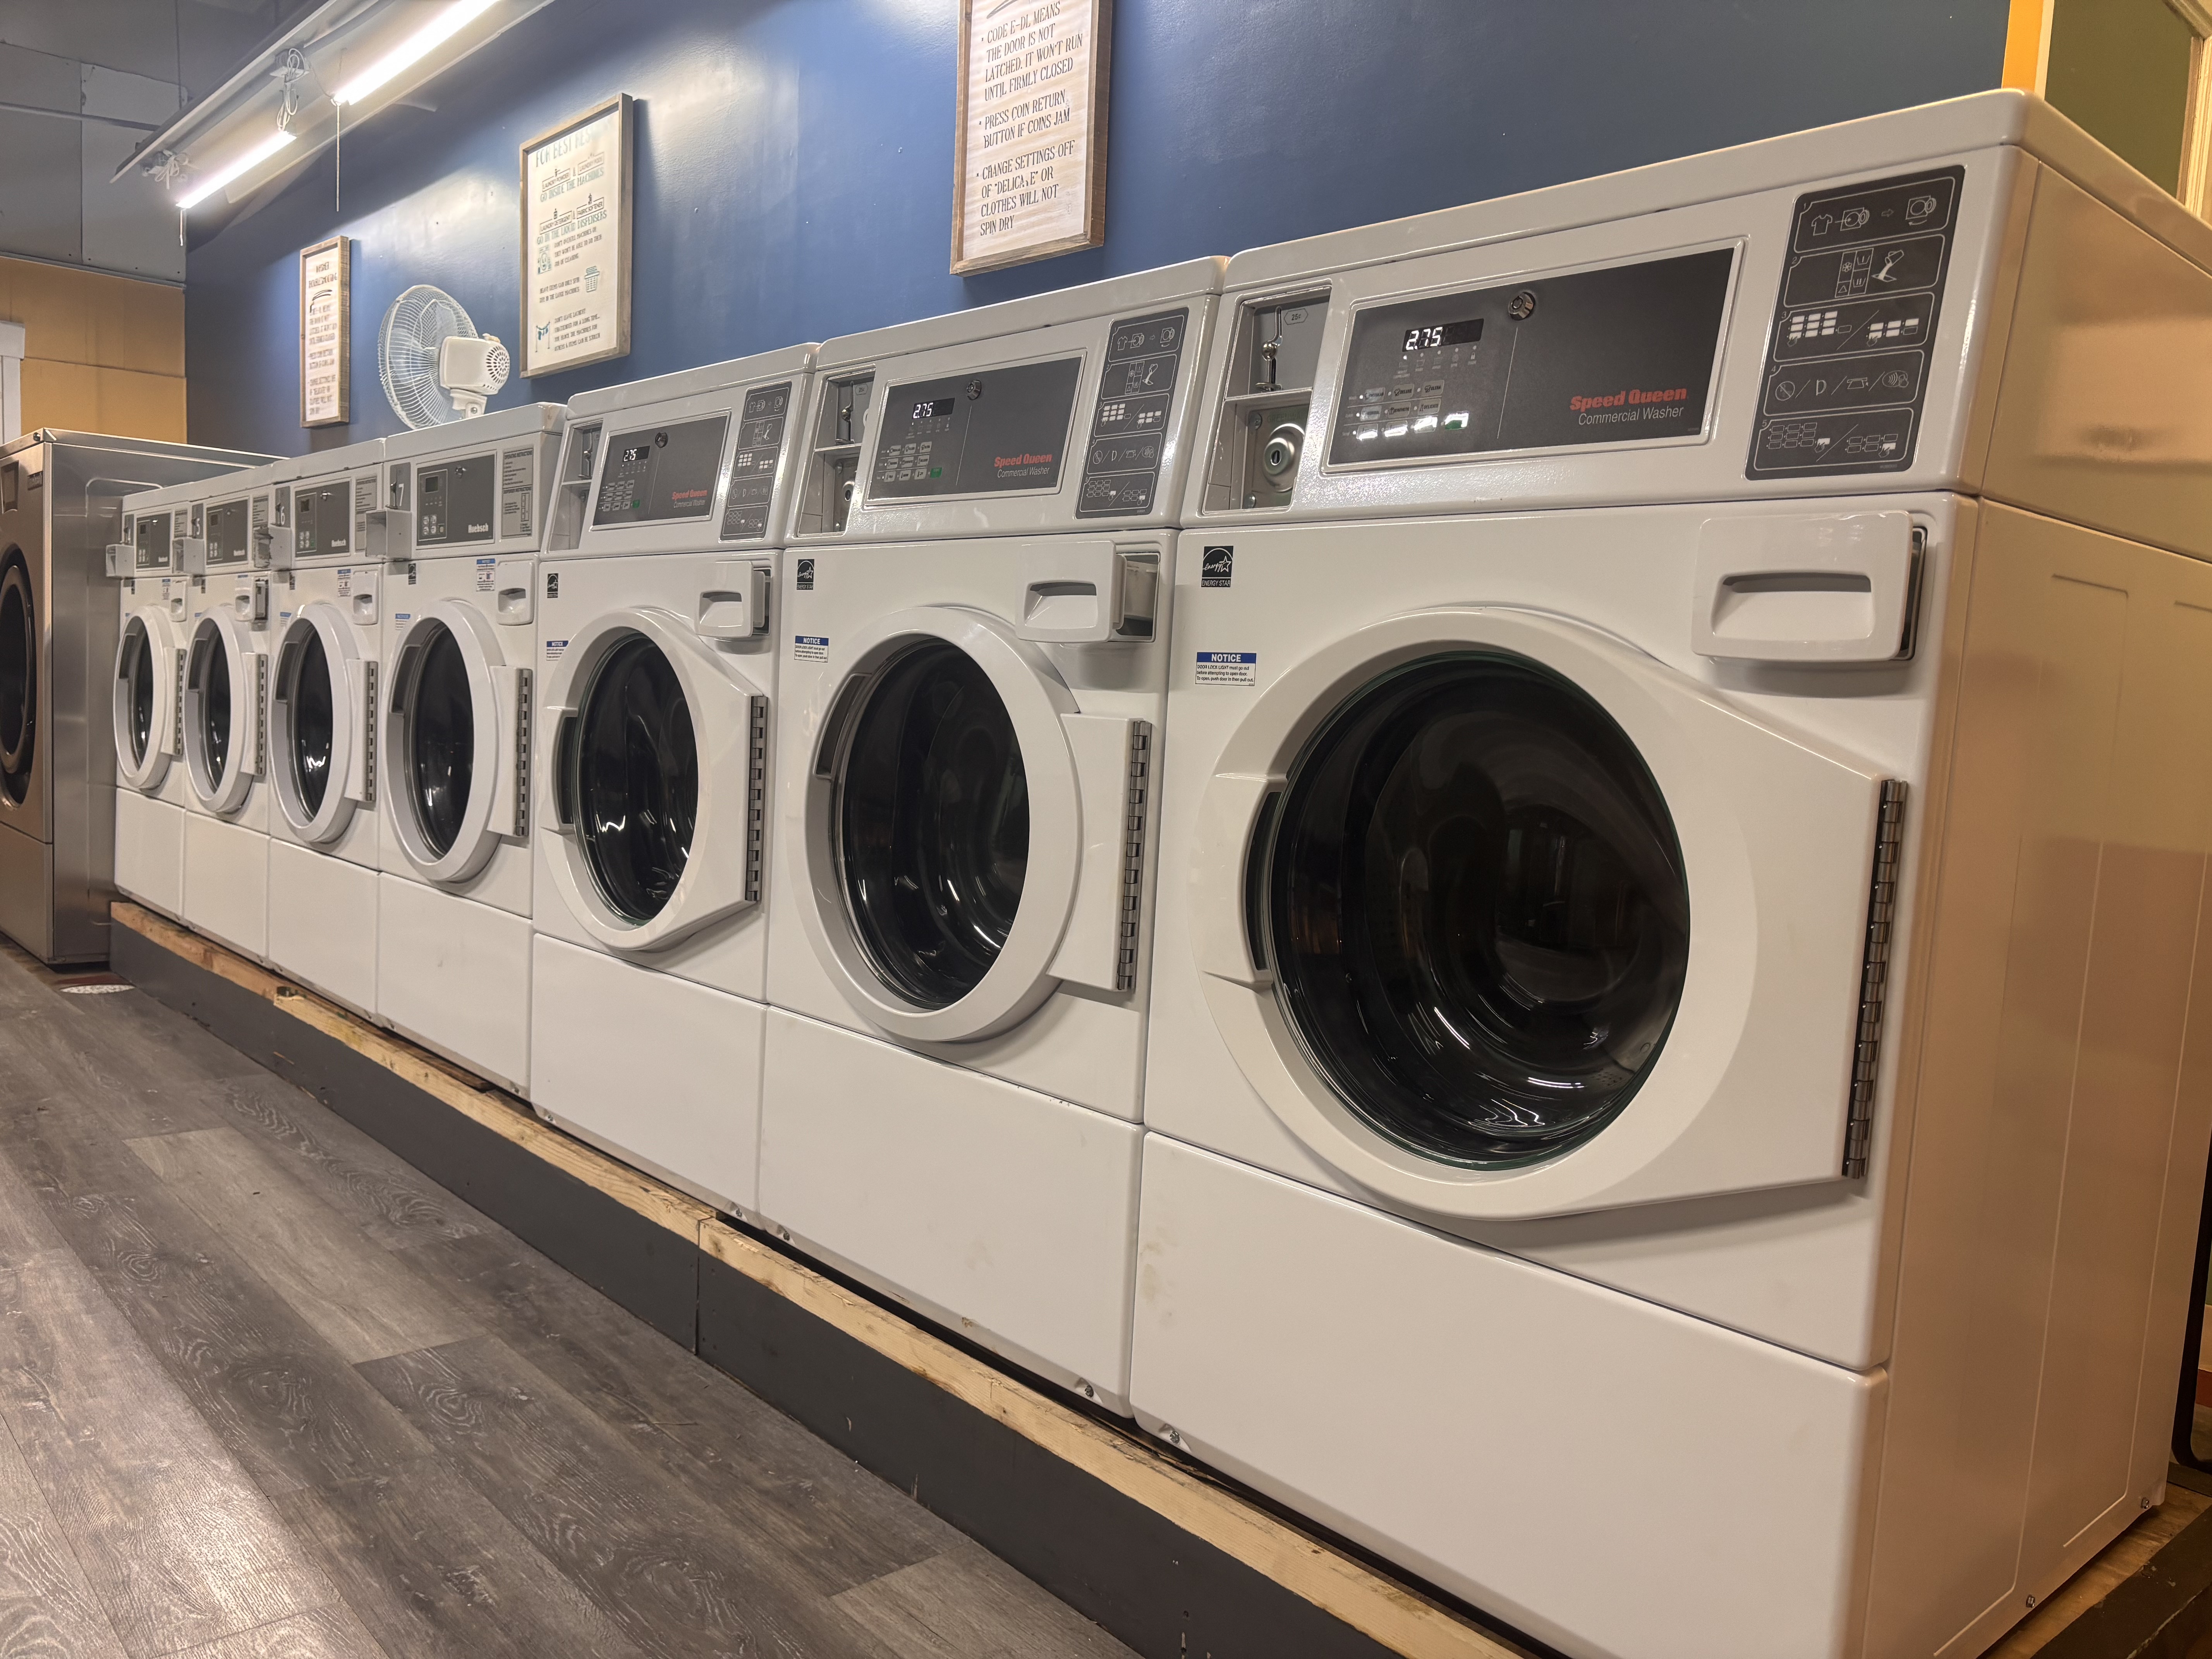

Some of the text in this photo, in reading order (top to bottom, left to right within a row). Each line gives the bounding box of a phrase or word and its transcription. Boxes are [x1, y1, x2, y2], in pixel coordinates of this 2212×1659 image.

[988, 1, 1060, 43] CODE E-DL MEANS
[987, 23, 1055, 62] THE DOOR IS NOT
[986, 33, 1082, 82] LATCHED. IT WON'T RUN
[985, 57, 1073, 101] UNTIL FIRMLY CLOSED
[985, 89, 1065, 130] PRESS COIN RETURN
[984, 108, 1070, 148] BUTTON IF COINS JAM
[536, 147, 550, 167] FOR
[553, 136, 571, 159] BEST
[982, 140, 1075, 180] CHANGE SETTINGS OFF
[982, 184, 992, 198] OF
[1041, 166, 1053, 181] OR
[981, 184, 1058, 217] CLOTHES WILL NOT
[981, 215, 1014, 236] SPIN DRY
[1406, 326, 1443, 350] 2.75
[913, 402, 933, 419] 2.75
[1570, 388, 1687, 412] Speed Queen
[1578, 406, 1684, 425] Commercial Washer
[994, 453, 1053, 469] Speed Queen
[998, 466, 1050, 478] Commercial Washer
[398, 483, 404, 506] 7
[197, 518, 200, 535] 5
[281, 506, 285, 525] 6
[1211, 654, 1241, 662] NOTICE
